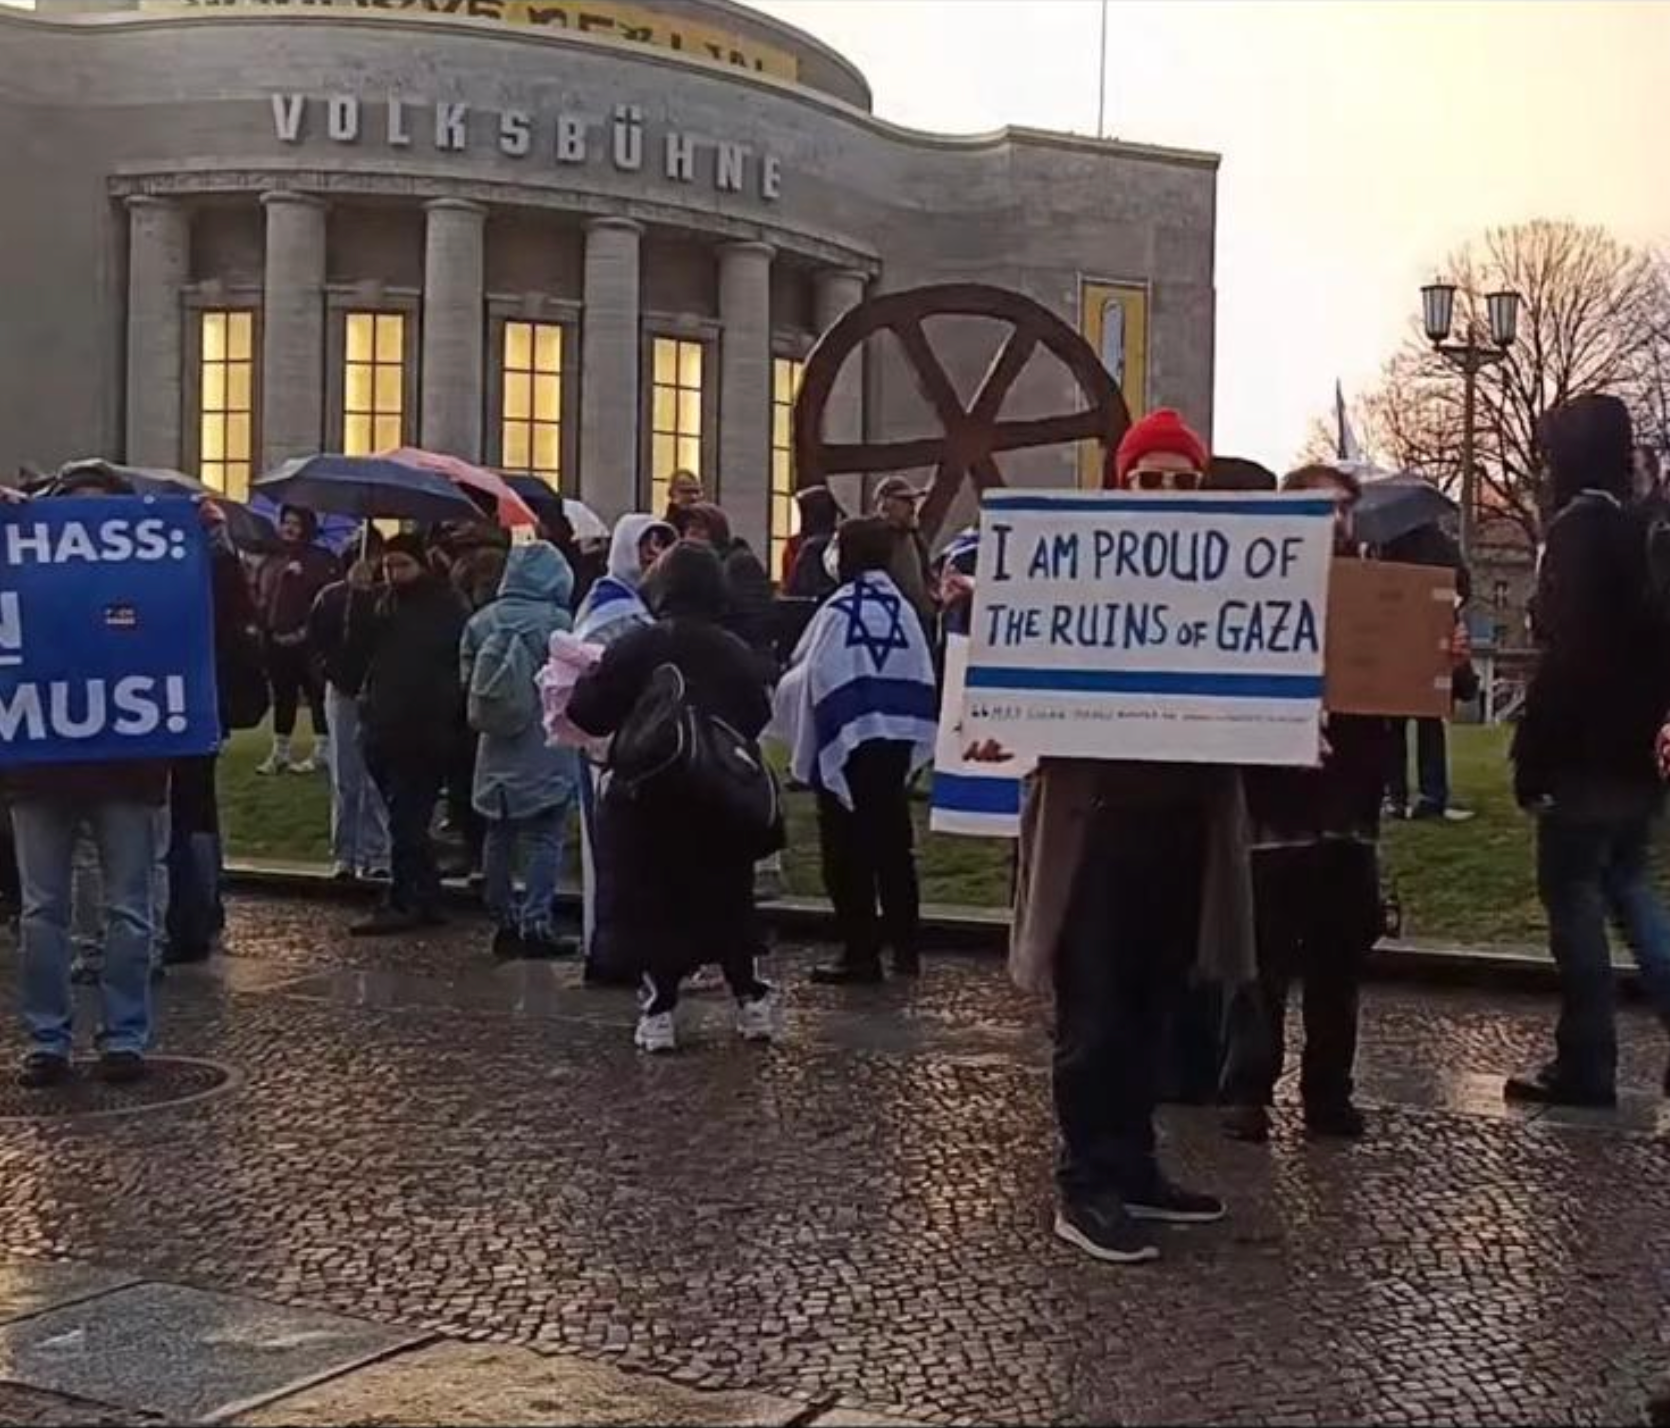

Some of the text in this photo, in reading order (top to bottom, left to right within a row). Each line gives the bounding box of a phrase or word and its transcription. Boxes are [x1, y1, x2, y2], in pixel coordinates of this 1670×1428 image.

[271, 93, 781, 200] VOLKSBÜHNE
[5, 519, 185, 565] HASS:
[992, 525, 1304, 582] I AM PROUD OF
[986, 600, 1319, 653] THE RUINS OF GAZA
